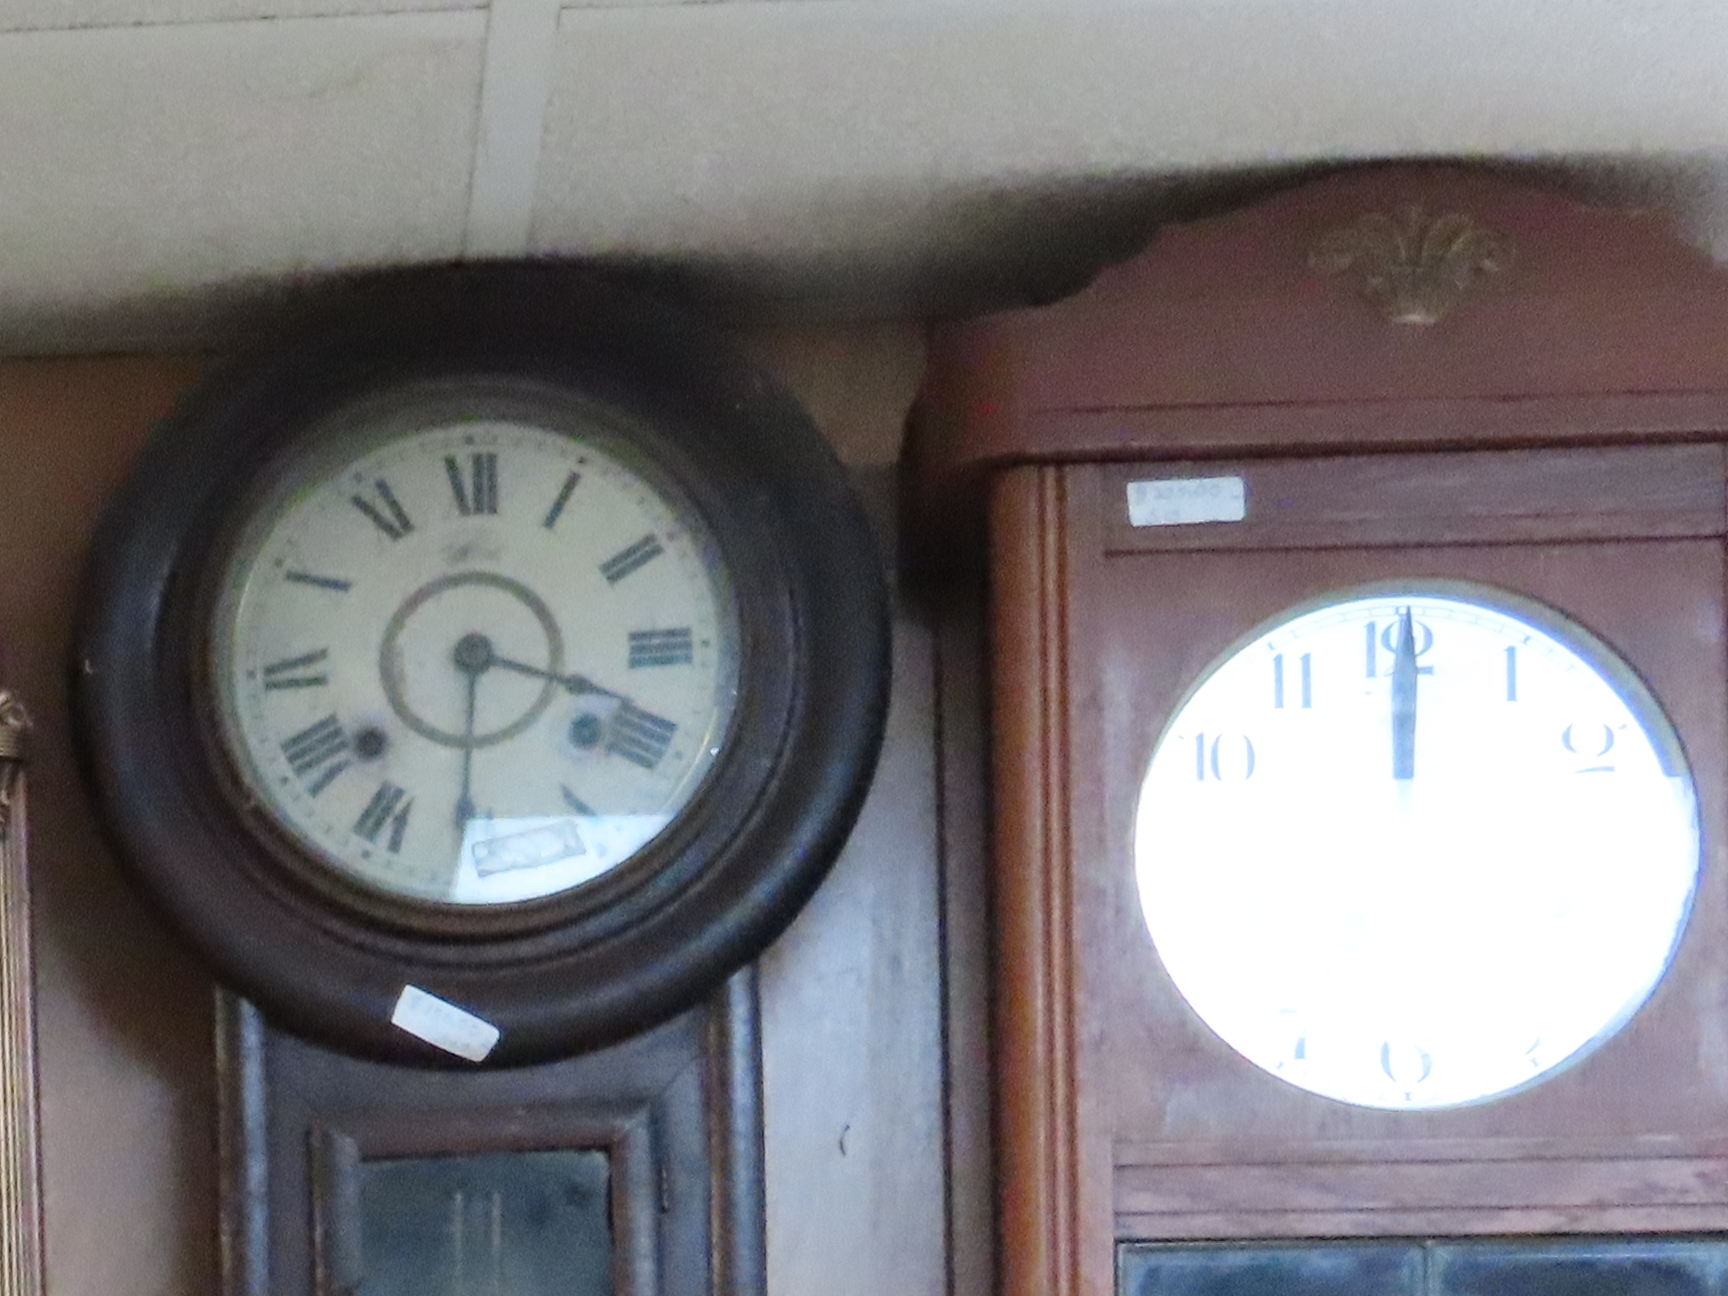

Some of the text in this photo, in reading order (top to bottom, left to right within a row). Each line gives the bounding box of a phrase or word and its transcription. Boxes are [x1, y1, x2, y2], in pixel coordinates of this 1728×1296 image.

[599, 533, 664, 585] II
[628, 627, 693, 669] III
[1271, 651, 1313, 709] 11
